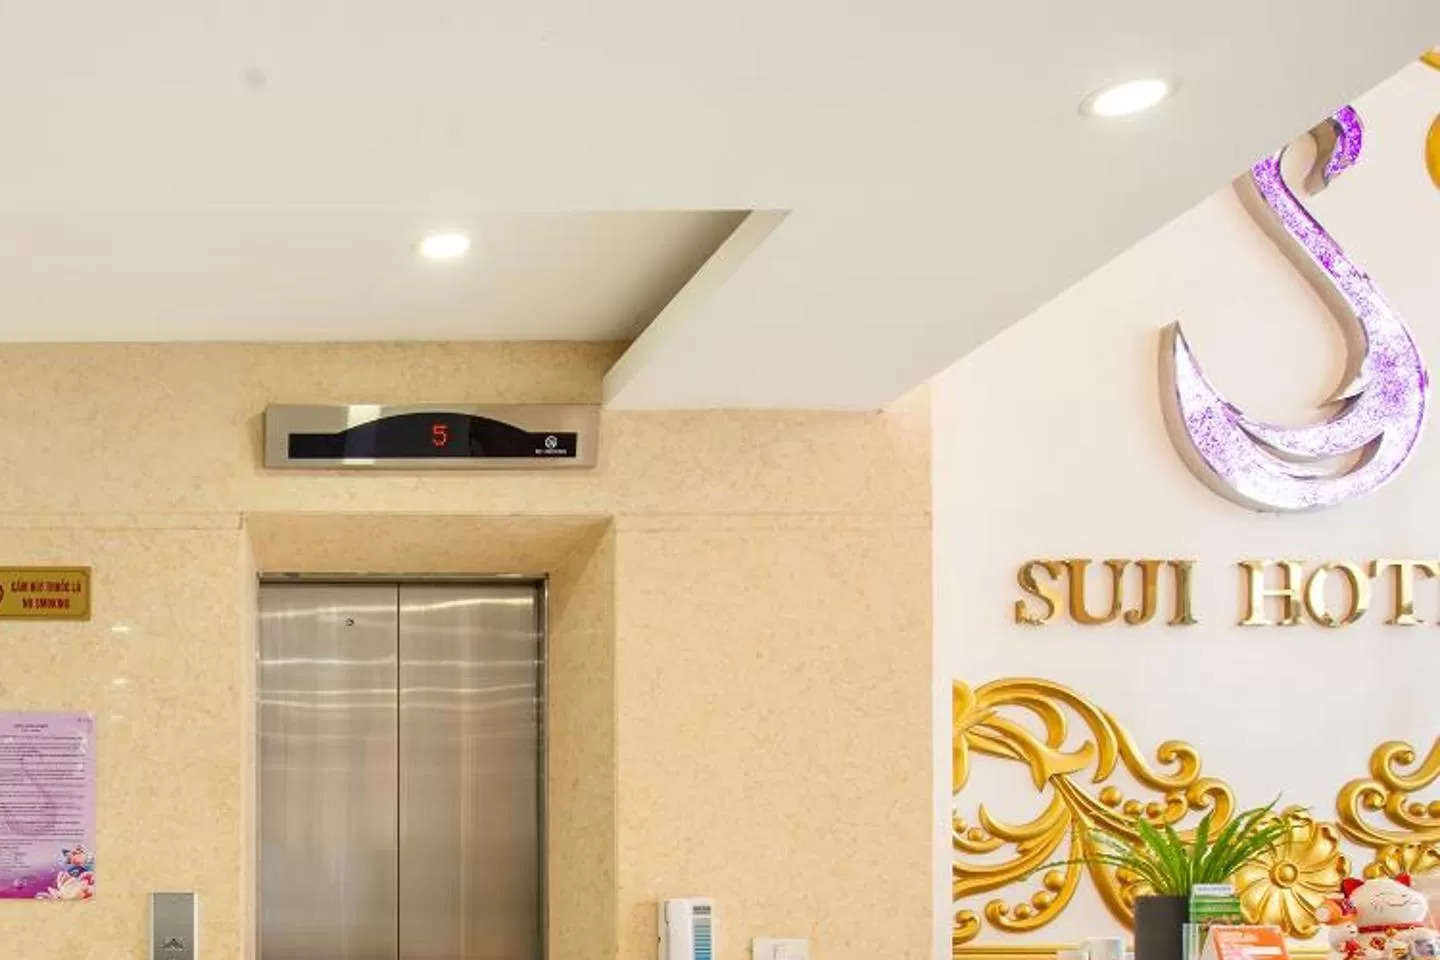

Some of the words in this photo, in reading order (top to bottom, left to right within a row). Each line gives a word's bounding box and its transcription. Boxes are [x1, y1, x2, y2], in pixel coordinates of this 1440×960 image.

[432, 424, 448, 447] 5
[1014, 557, 1199, 627] SUJI
[1236, 557, 1440, 628] HOT
